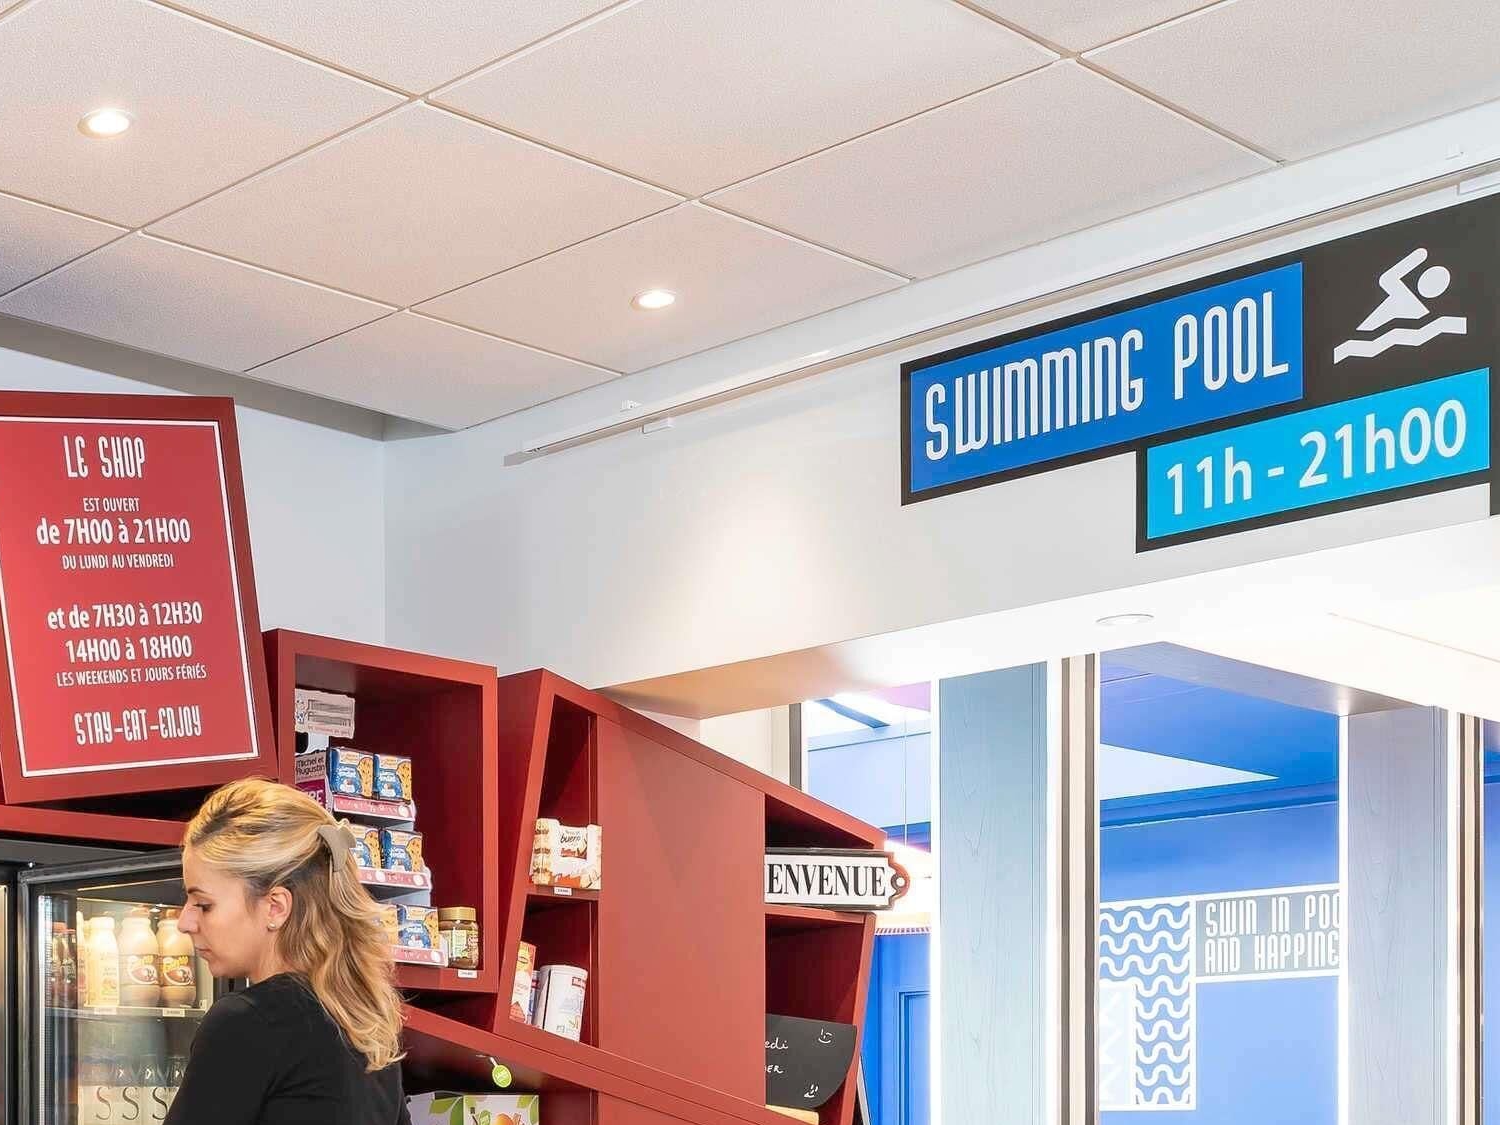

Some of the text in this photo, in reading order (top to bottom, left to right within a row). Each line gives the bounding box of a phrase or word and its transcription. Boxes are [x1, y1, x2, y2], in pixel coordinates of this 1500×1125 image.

[1173, 290, 1290, 401] POOL
[63, 435, 147, 479] LE SHOP
[1165, 445, 1253, 516] 11h
[1298, 399, 1468, 490] 21h00
[83, 497, 141, 513] EST OUVERT
[36, 518, 191, 545] de 7H00 à 21H00
[62, 553, 175, 570] DU LUNDI AU VENDREDI
[47, 601, 203, 630] et de 7H30 à 12H30
[65, 635, 193, 664] 14H00 à 18H00
[56, 662, 208, 688] LES WEEKENDS ET JOURS FÉRIÉS
[766, 862, 887, 898] ENVENUE
[1304, 893, 1340, 931] POO
[1204, 930, 1340, 974] AND HAPPINE
[764, 1037, 789, 1051] edi
